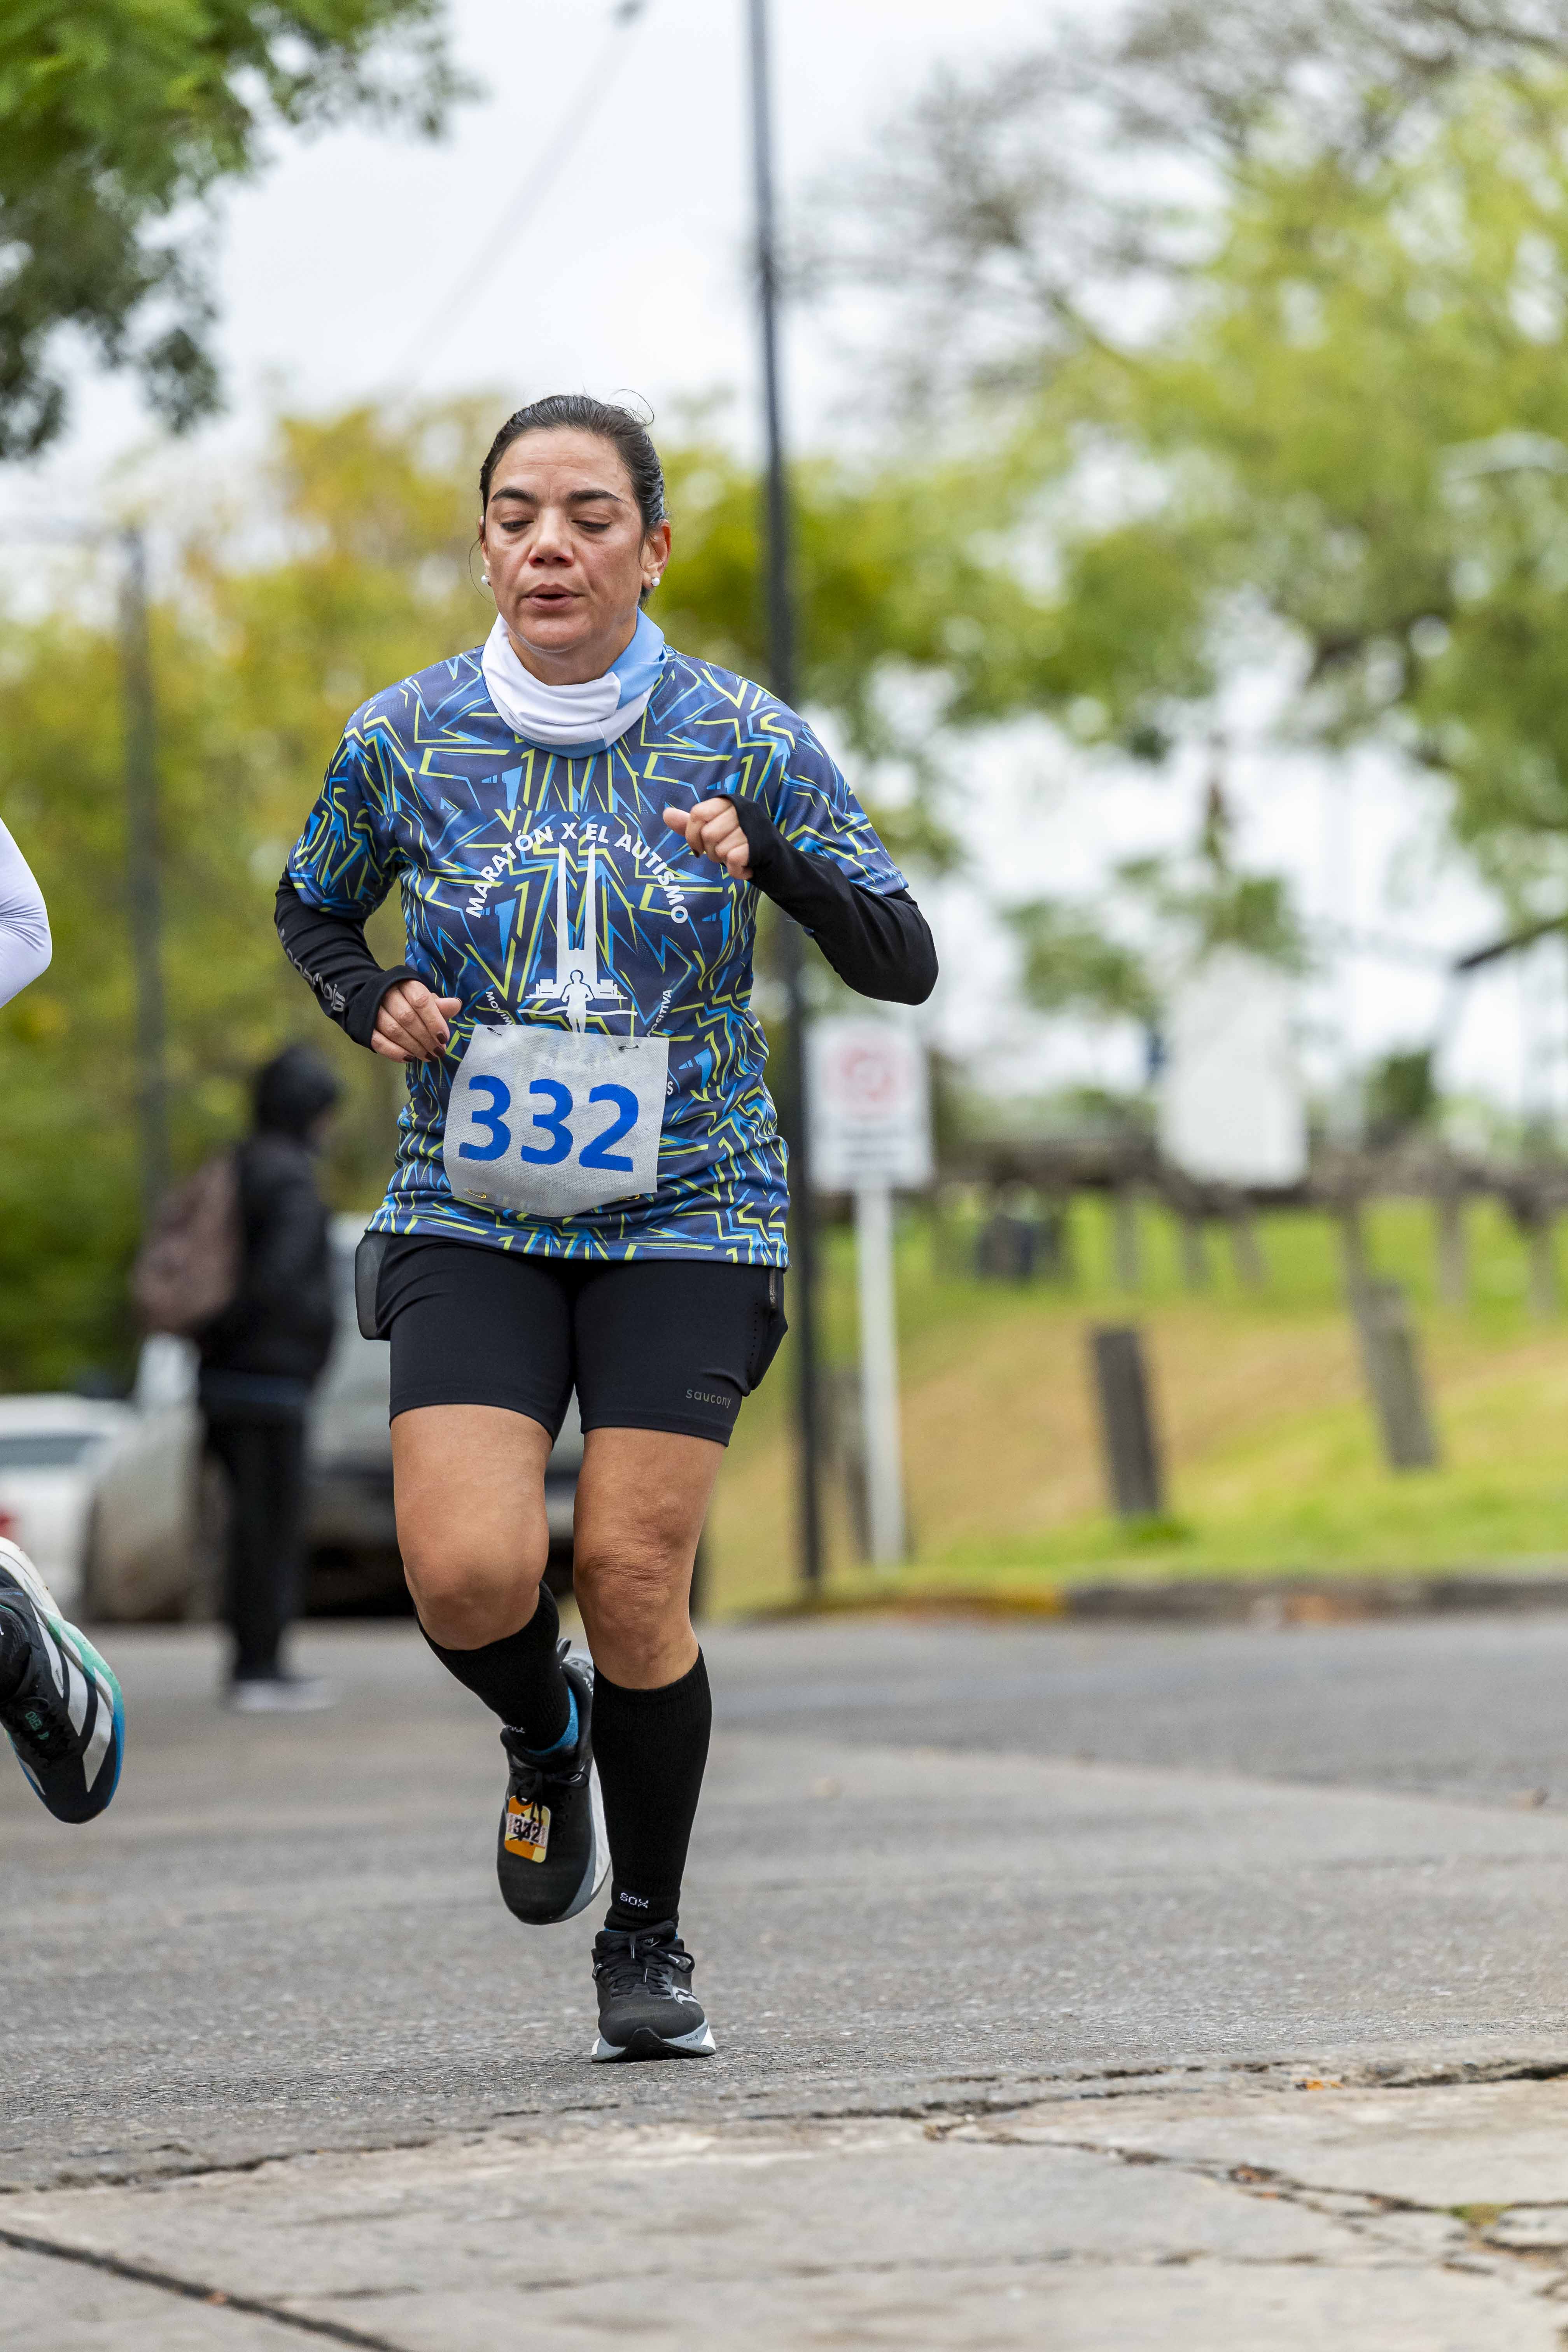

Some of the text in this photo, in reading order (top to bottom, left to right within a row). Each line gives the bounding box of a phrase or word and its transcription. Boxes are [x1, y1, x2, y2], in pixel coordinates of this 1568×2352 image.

[466, 822, 689, 924] MARATÓN X EL AUTISMO
[485, 991, 515, 1026] MOVIM
[458, 1074, 639, 1172] 332
[685, 1389, 732, 1409] saucony
